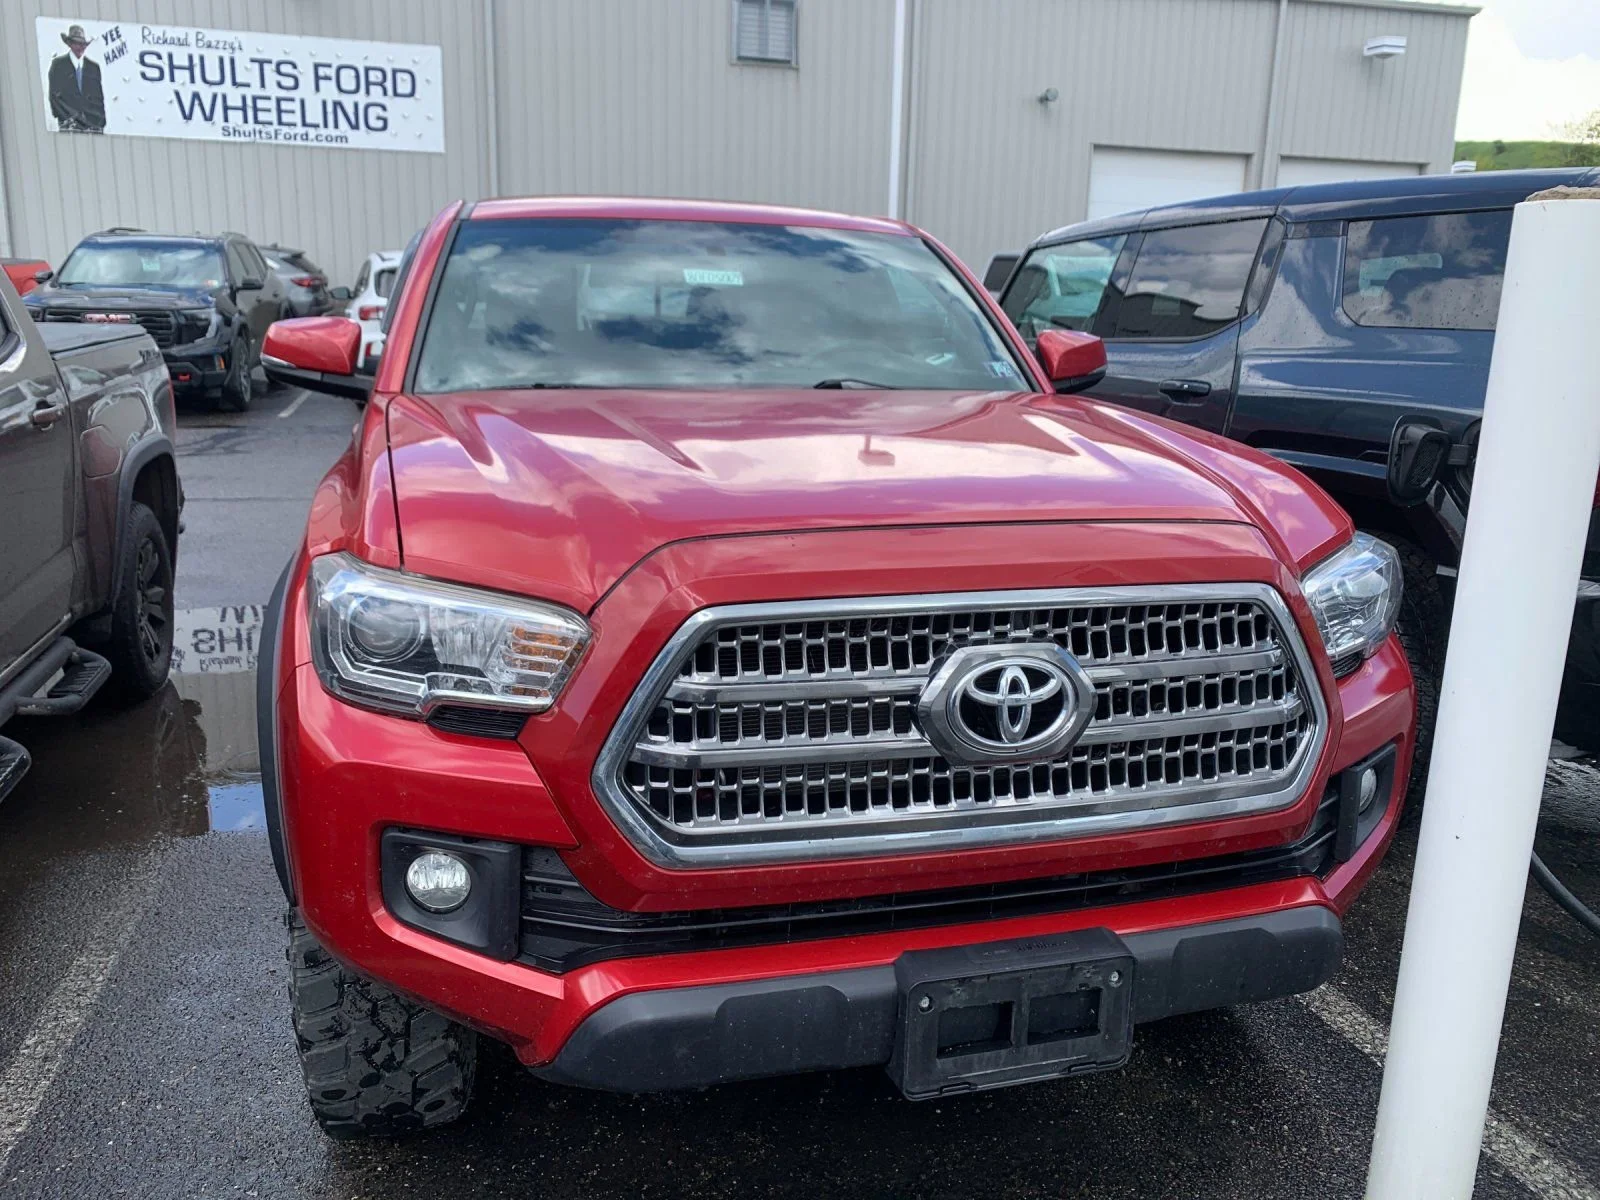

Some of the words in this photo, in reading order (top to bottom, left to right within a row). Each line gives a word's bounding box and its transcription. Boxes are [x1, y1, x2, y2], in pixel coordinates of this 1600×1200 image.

[101, 25, 122, 46] YEE
[141, 25, 191, 47] Richard
[103, 41, 128, 65] HAW!
[139, 49, 300, 91] SHULTS
[313, 62, 417, 98] FORD
[174, 90, 389, 132] WHEELING
[221, 126, 349, 144] ShultsFord.com
